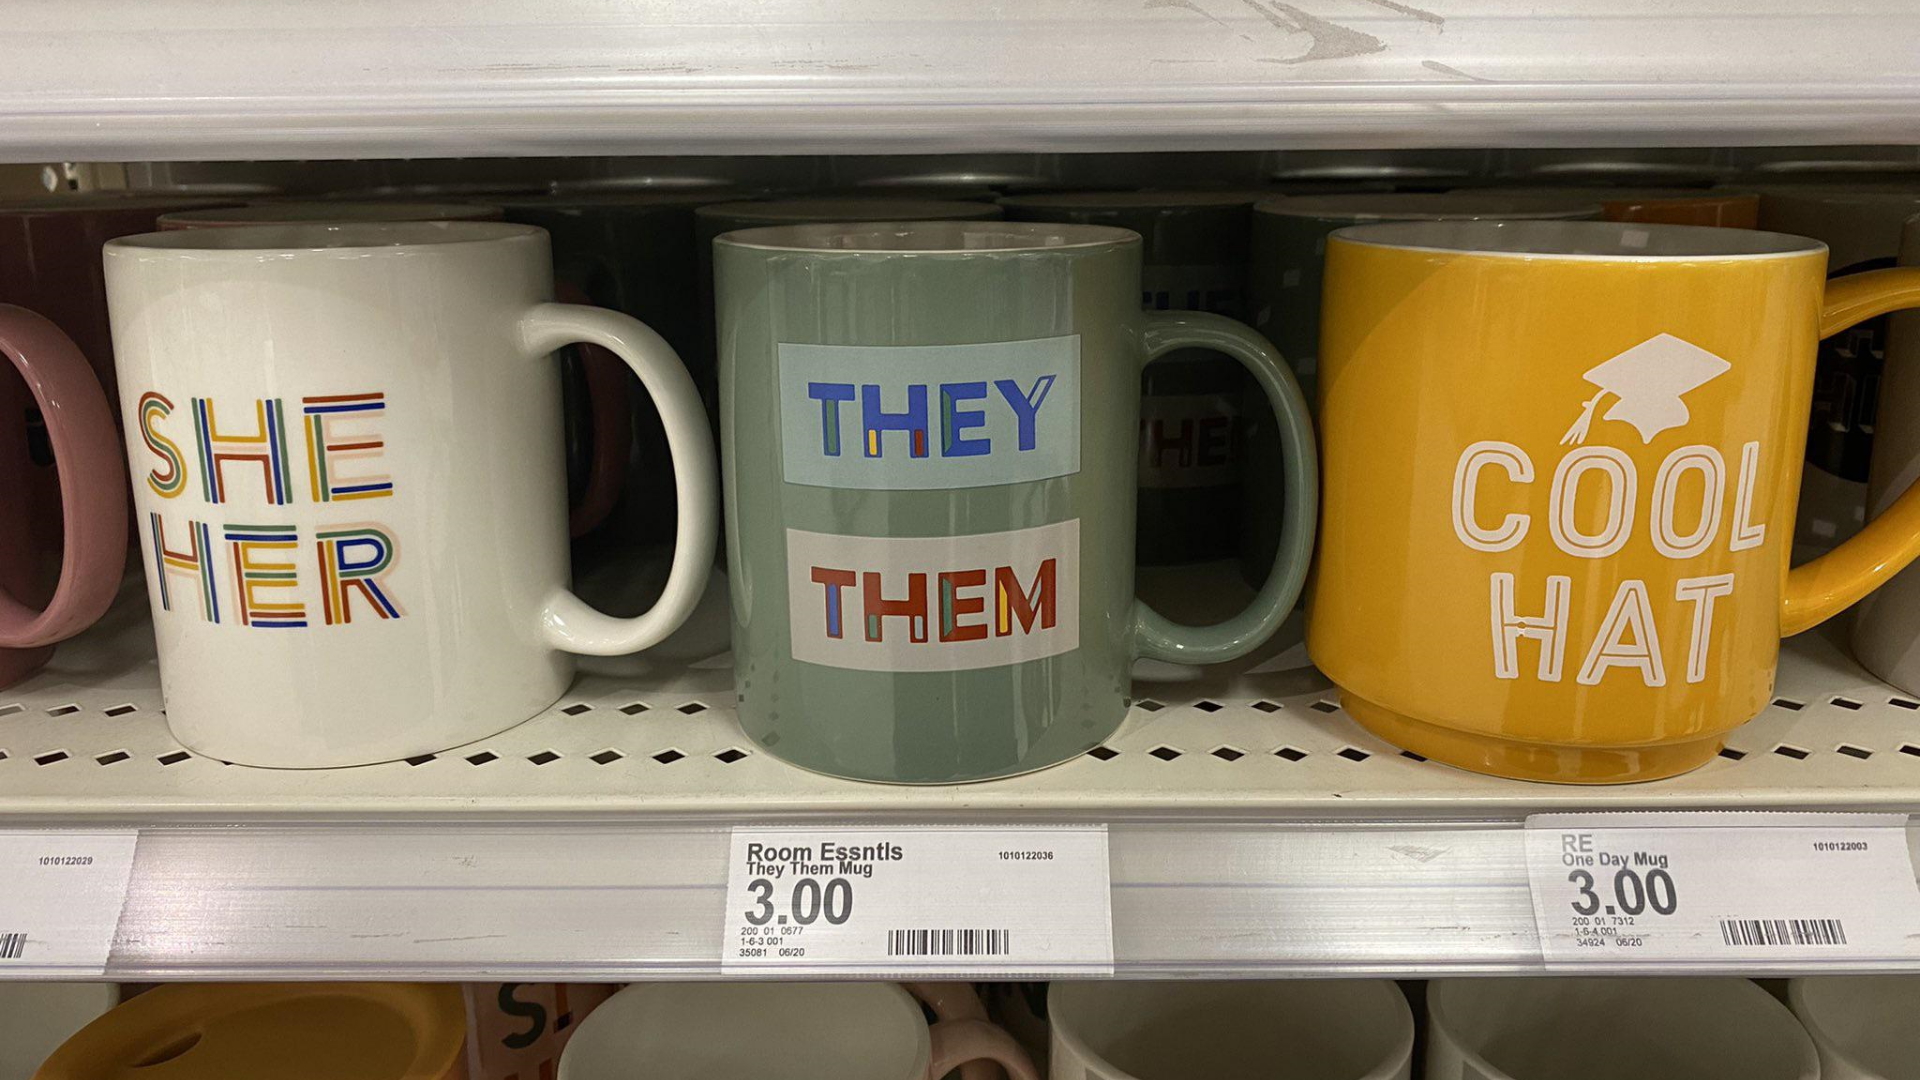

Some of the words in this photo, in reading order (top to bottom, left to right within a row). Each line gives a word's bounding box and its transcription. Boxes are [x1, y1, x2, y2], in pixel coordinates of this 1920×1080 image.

[808, 374, 1057, 459] THEY
[138, 391, 393, 505] SHE
[1452, 441, 1766, 559] COOL
[150, 511, 408, 627] HER
[811, 558, 1057, 643] THEM
[1490, 572, 1735, 687] HAT
[747, 842, 812, 862] Room
[820, 842, 904, 861] Essntls
[1561, 833, 1594, 853] RE
[1813, 842, 1868, 851] 1010122003
[39, 856, 94, 866] 1010122029
[998, 851, 1054, 860] 1010122036
[1562, 853, 1594, 866] One
[1599, 852, 1629, 869] Day
[1634, 852, 1668, 868] Mug
[746, 861, 785, 879] They
[790, 861, 834, 876] Them
[839, 861, 873, 878] Mug
[744, 877, 853, 926] 3.00
[1568, 868, 1677, 916] 3.00
[741, 927, 759, 936] 200
[764, 927, 775, 936] 01
[781, 926, 804, 936] 0677
[1572, 916, 1590, 926] 200
[1594, 916, 1606, 926] 01
[1611, 916, 1635, 926] 7312
[739, 948, 768, 957] 35081
[778, 947, 805, 957] 06/20
[1576, 938, 1605, 947] 34924
[1615, 937, 1643, 947] 06/20
